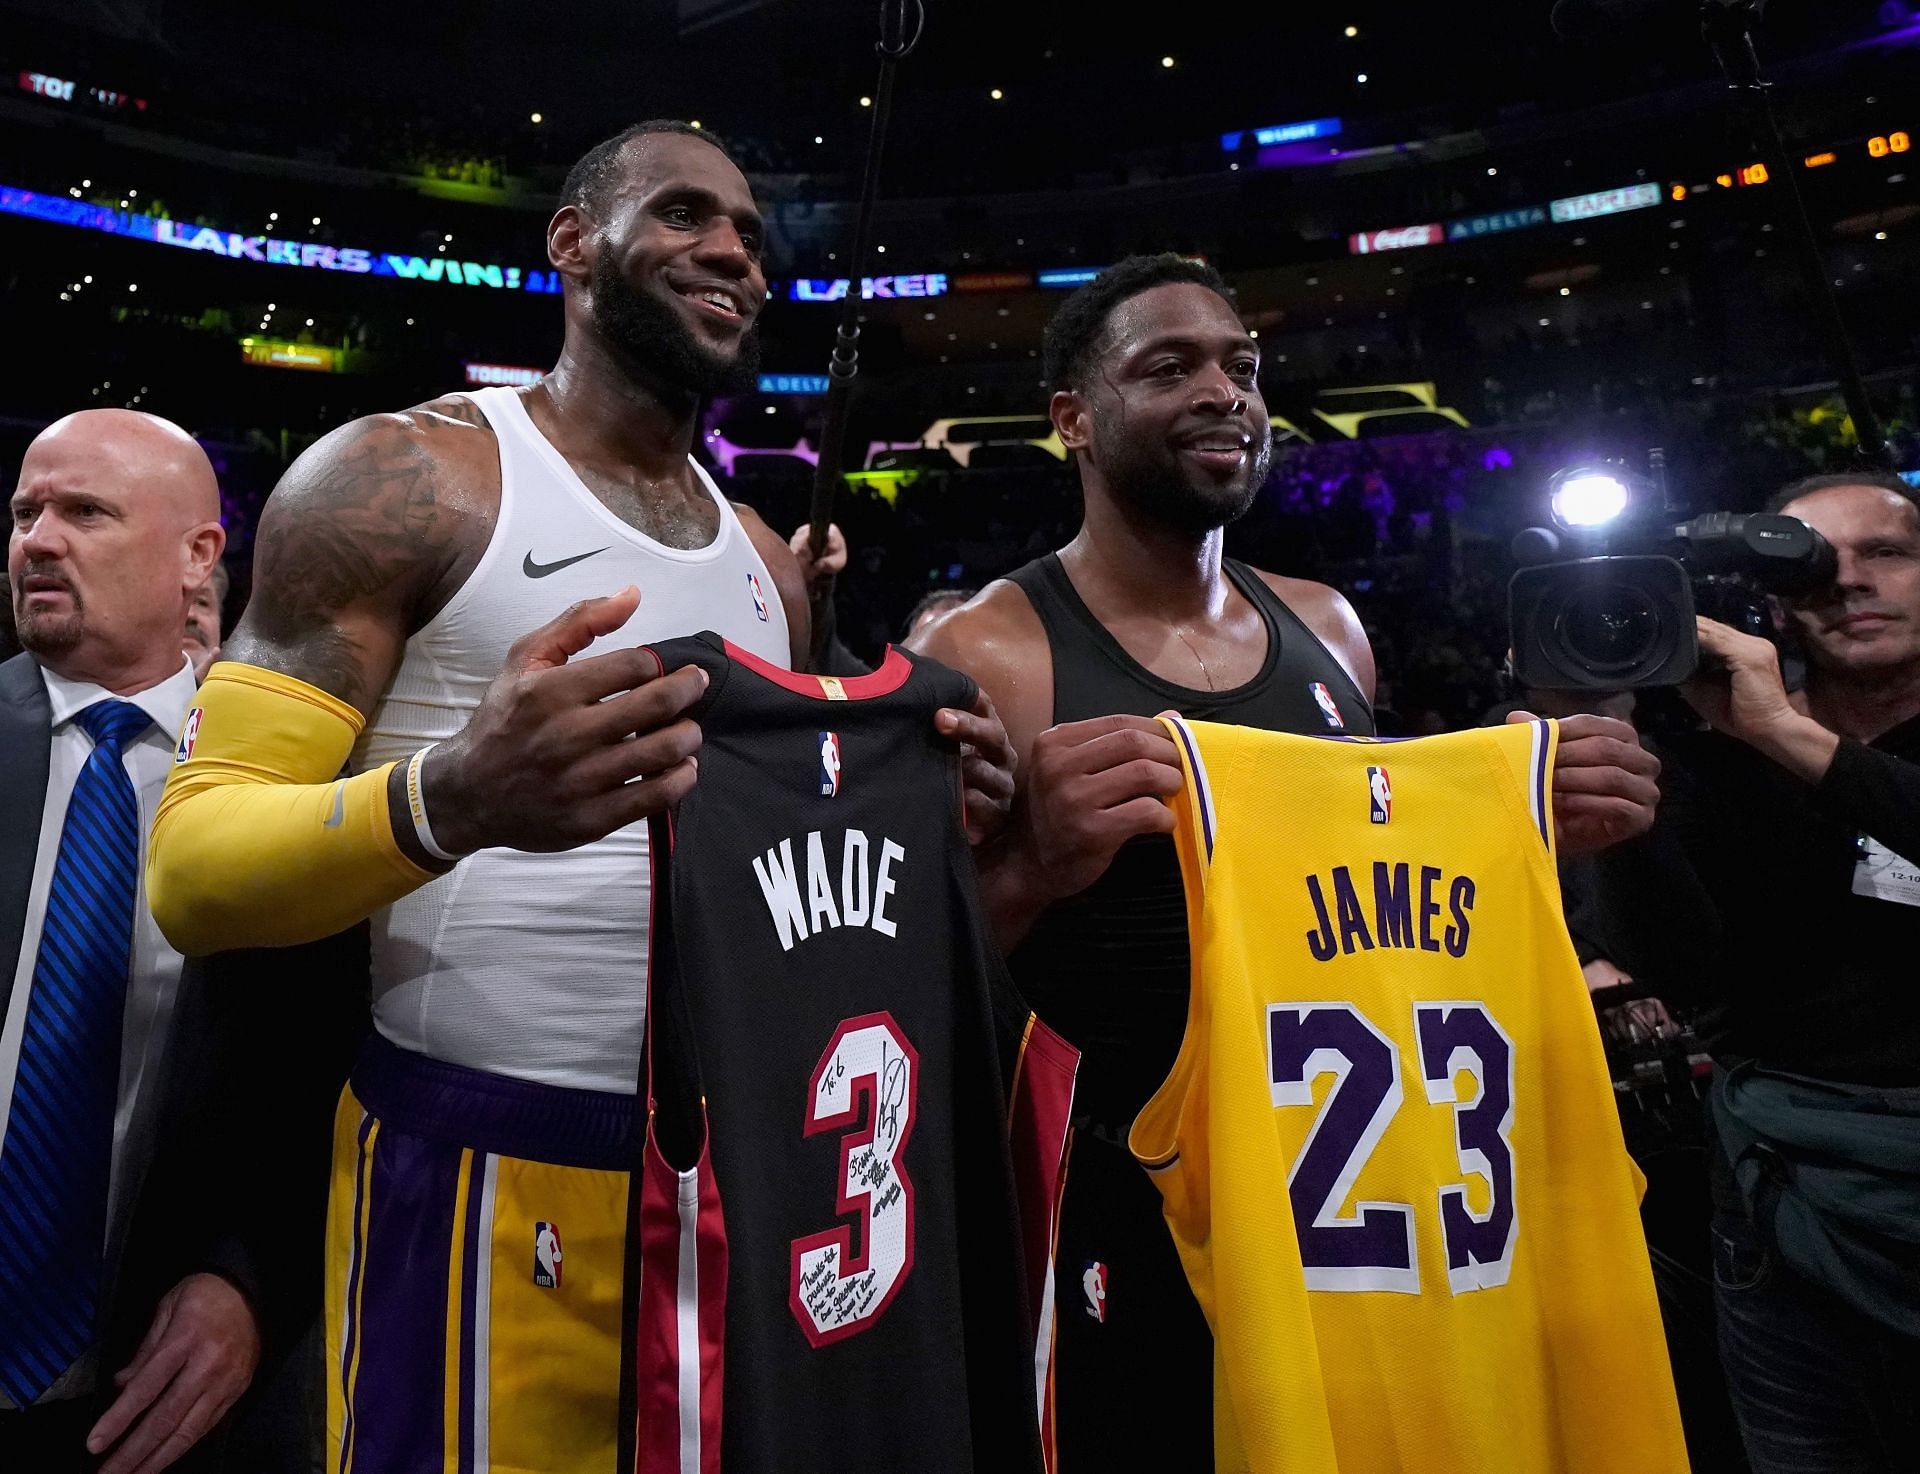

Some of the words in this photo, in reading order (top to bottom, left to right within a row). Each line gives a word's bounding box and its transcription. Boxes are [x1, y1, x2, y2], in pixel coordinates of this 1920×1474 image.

[157, 217, 372, 274] LAKERS
[386, 255, 521, 289] WIN!
[1472, 207, 1547, 234] DELTA
[752, 828, 905, 951] WADE
[1306, 861, 1476, 962] JAMES
[789, 1010, 921, 1350] 3
[1265, 1000, 1519, 1297] 23
[536, 1275, 551, 1287] NBA
